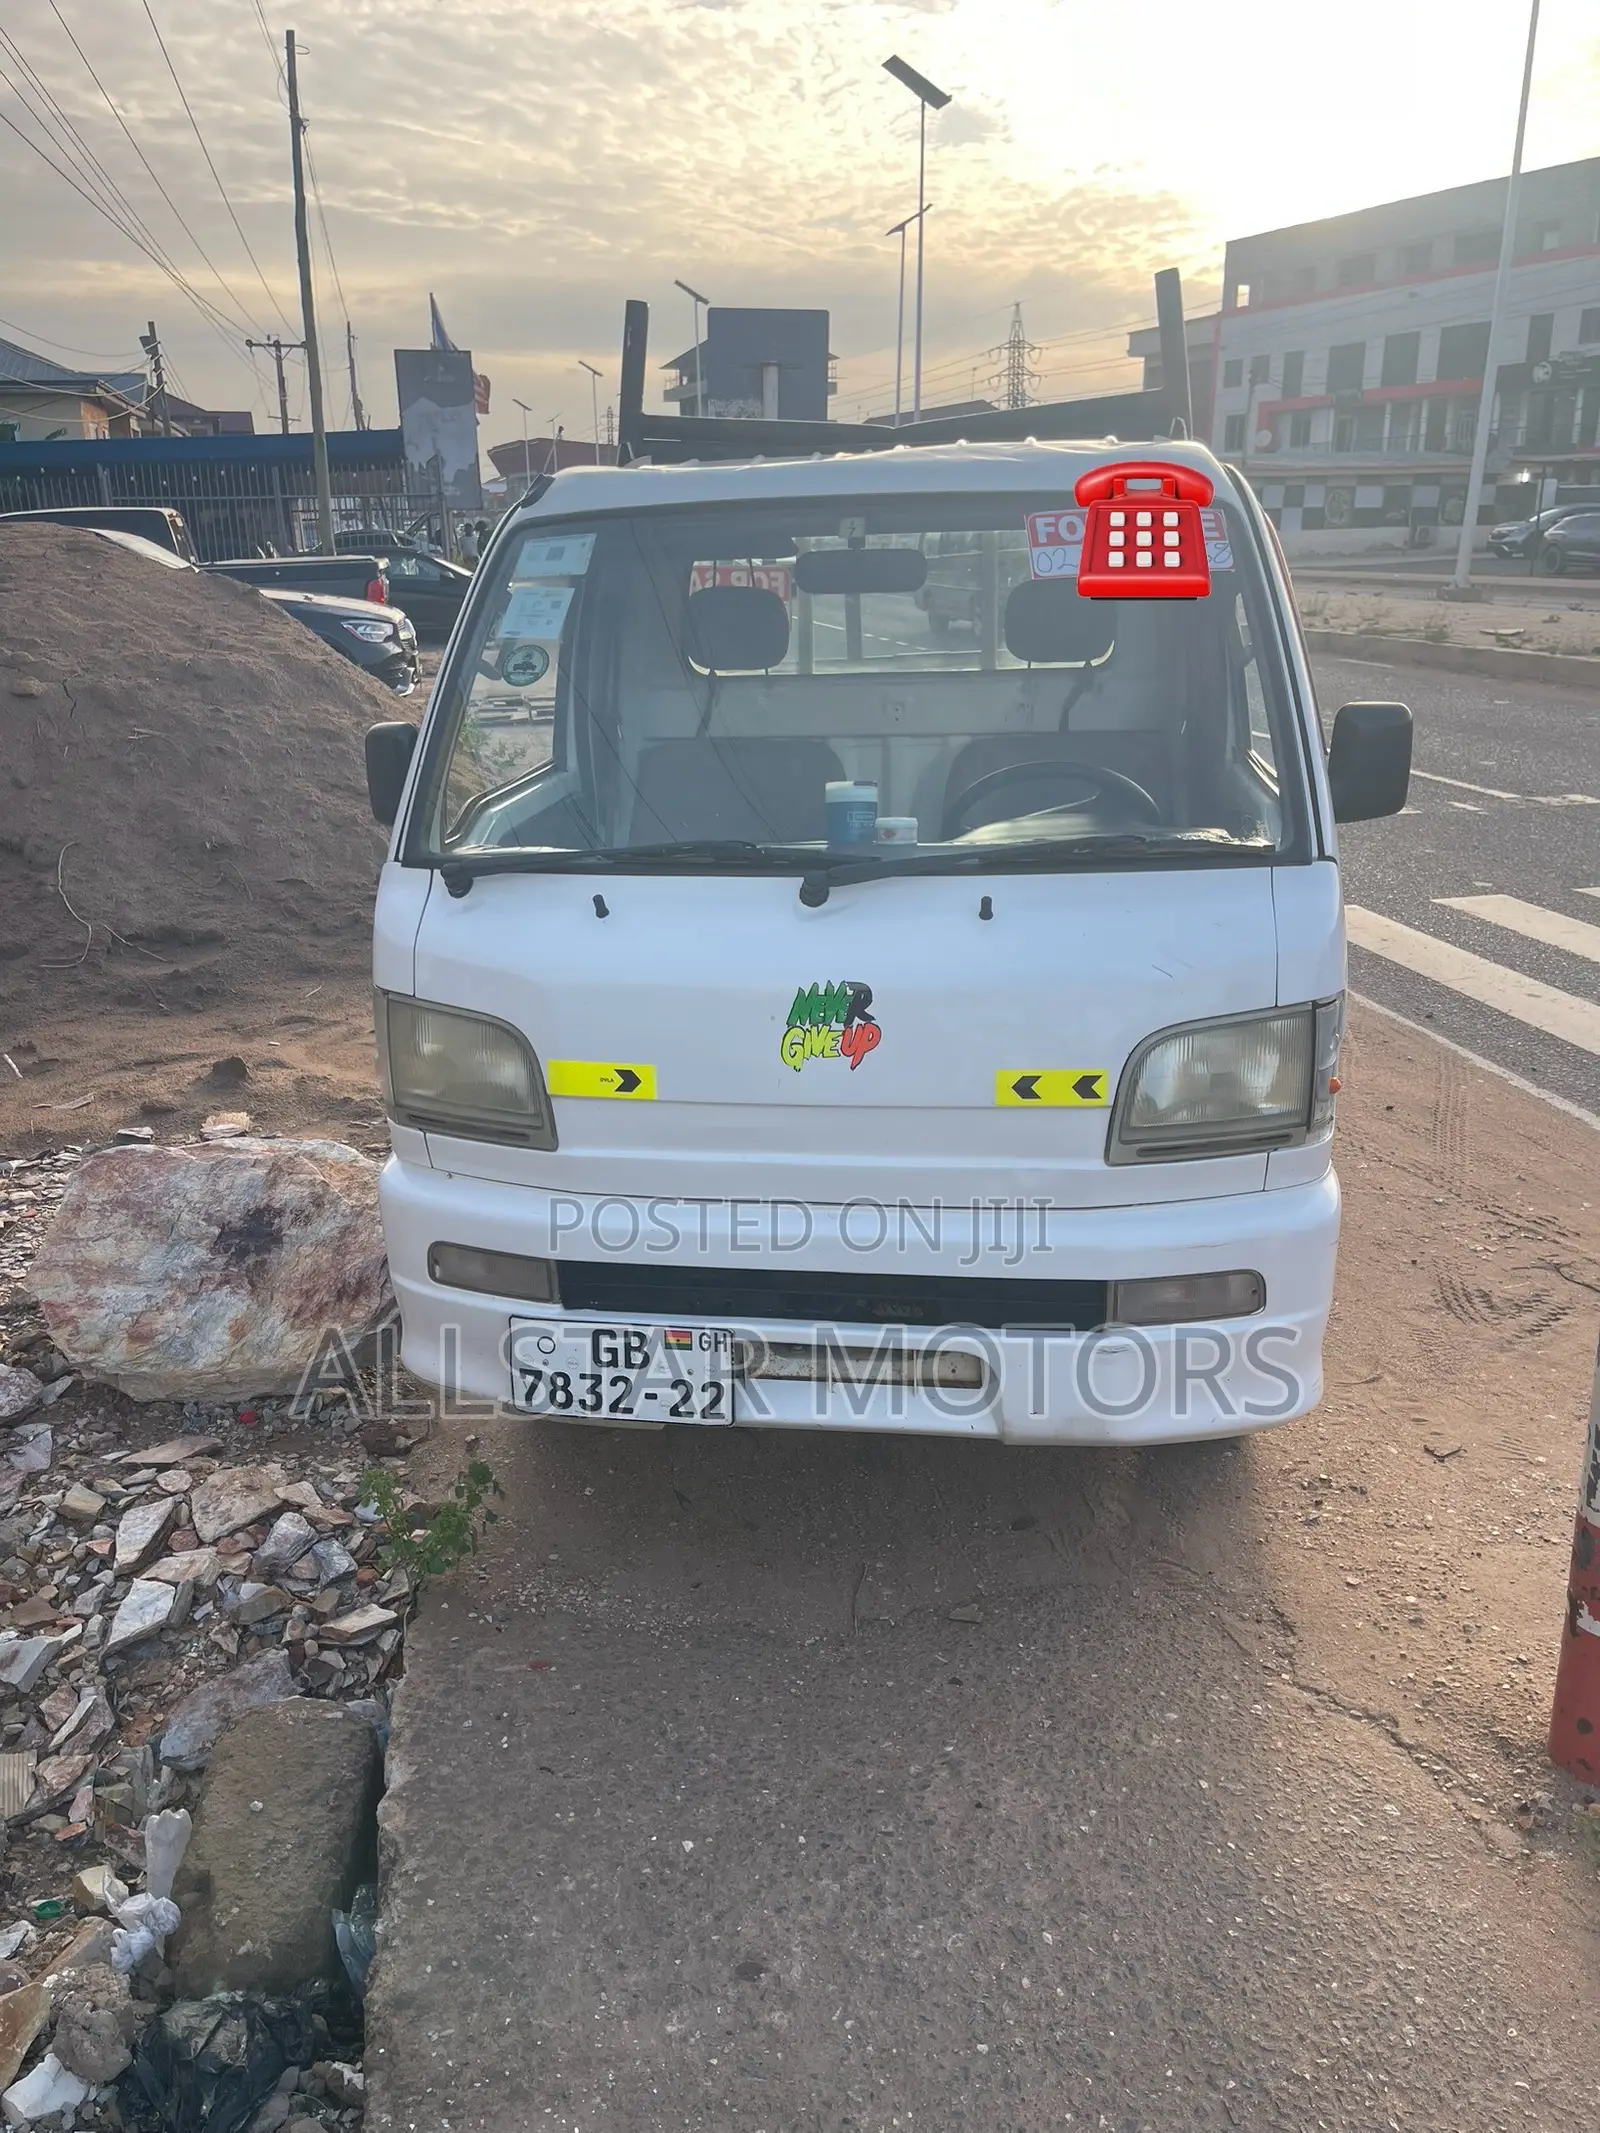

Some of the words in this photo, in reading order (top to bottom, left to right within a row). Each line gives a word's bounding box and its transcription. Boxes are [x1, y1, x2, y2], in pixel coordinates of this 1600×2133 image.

[1035, 514, 1087, 544] FO
[781, 1025, 843, 1072] GIVE
[840, 1022, 882, 1071] UP
[592, 1328, 650, 1369] GB
[698, 1332, 728, 1353] GH
[519, 1369, 726, 1420] 7832-22
